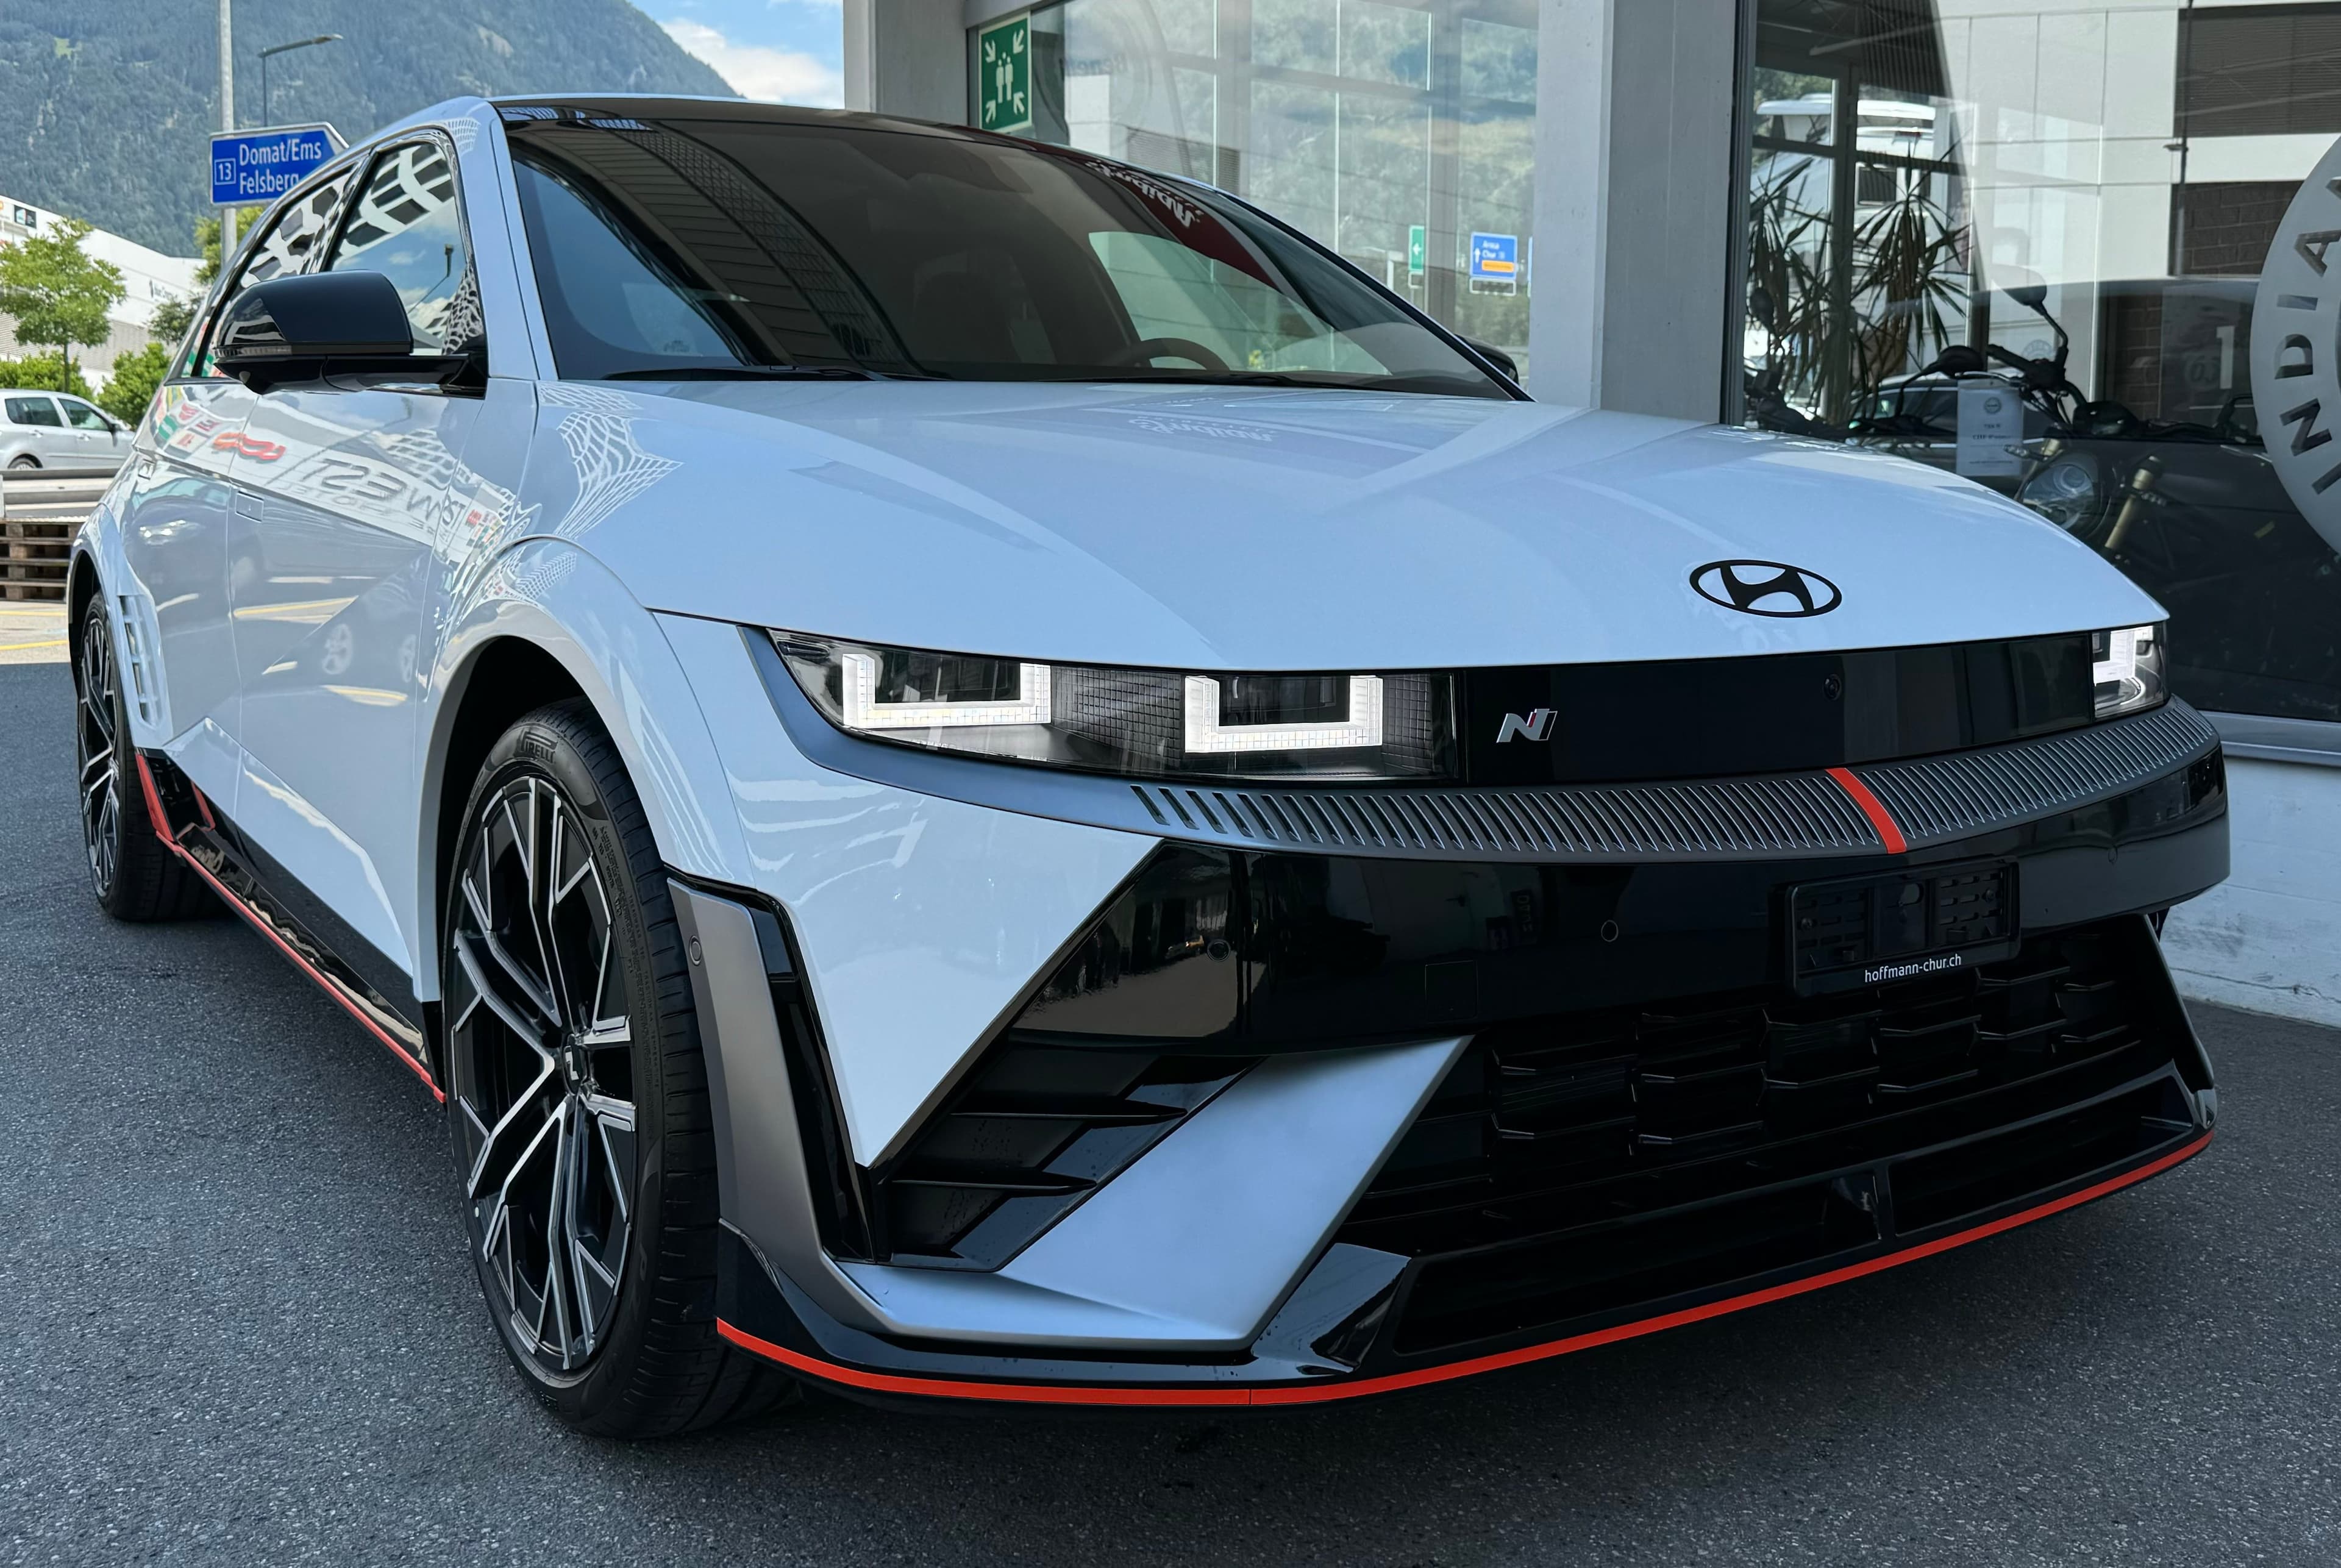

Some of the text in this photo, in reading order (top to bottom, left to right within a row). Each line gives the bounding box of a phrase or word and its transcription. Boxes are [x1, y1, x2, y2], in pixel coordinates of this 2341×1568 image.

[239, 138, 322, 166] Domat/Ems
[218, 163, 232, 181] 13
[2275, 176, 2341, 496] INDIA
[518, 730, 558, 763] PIRELLI
[1864, 953, 1962, 983] hoffmann-chur.ch
